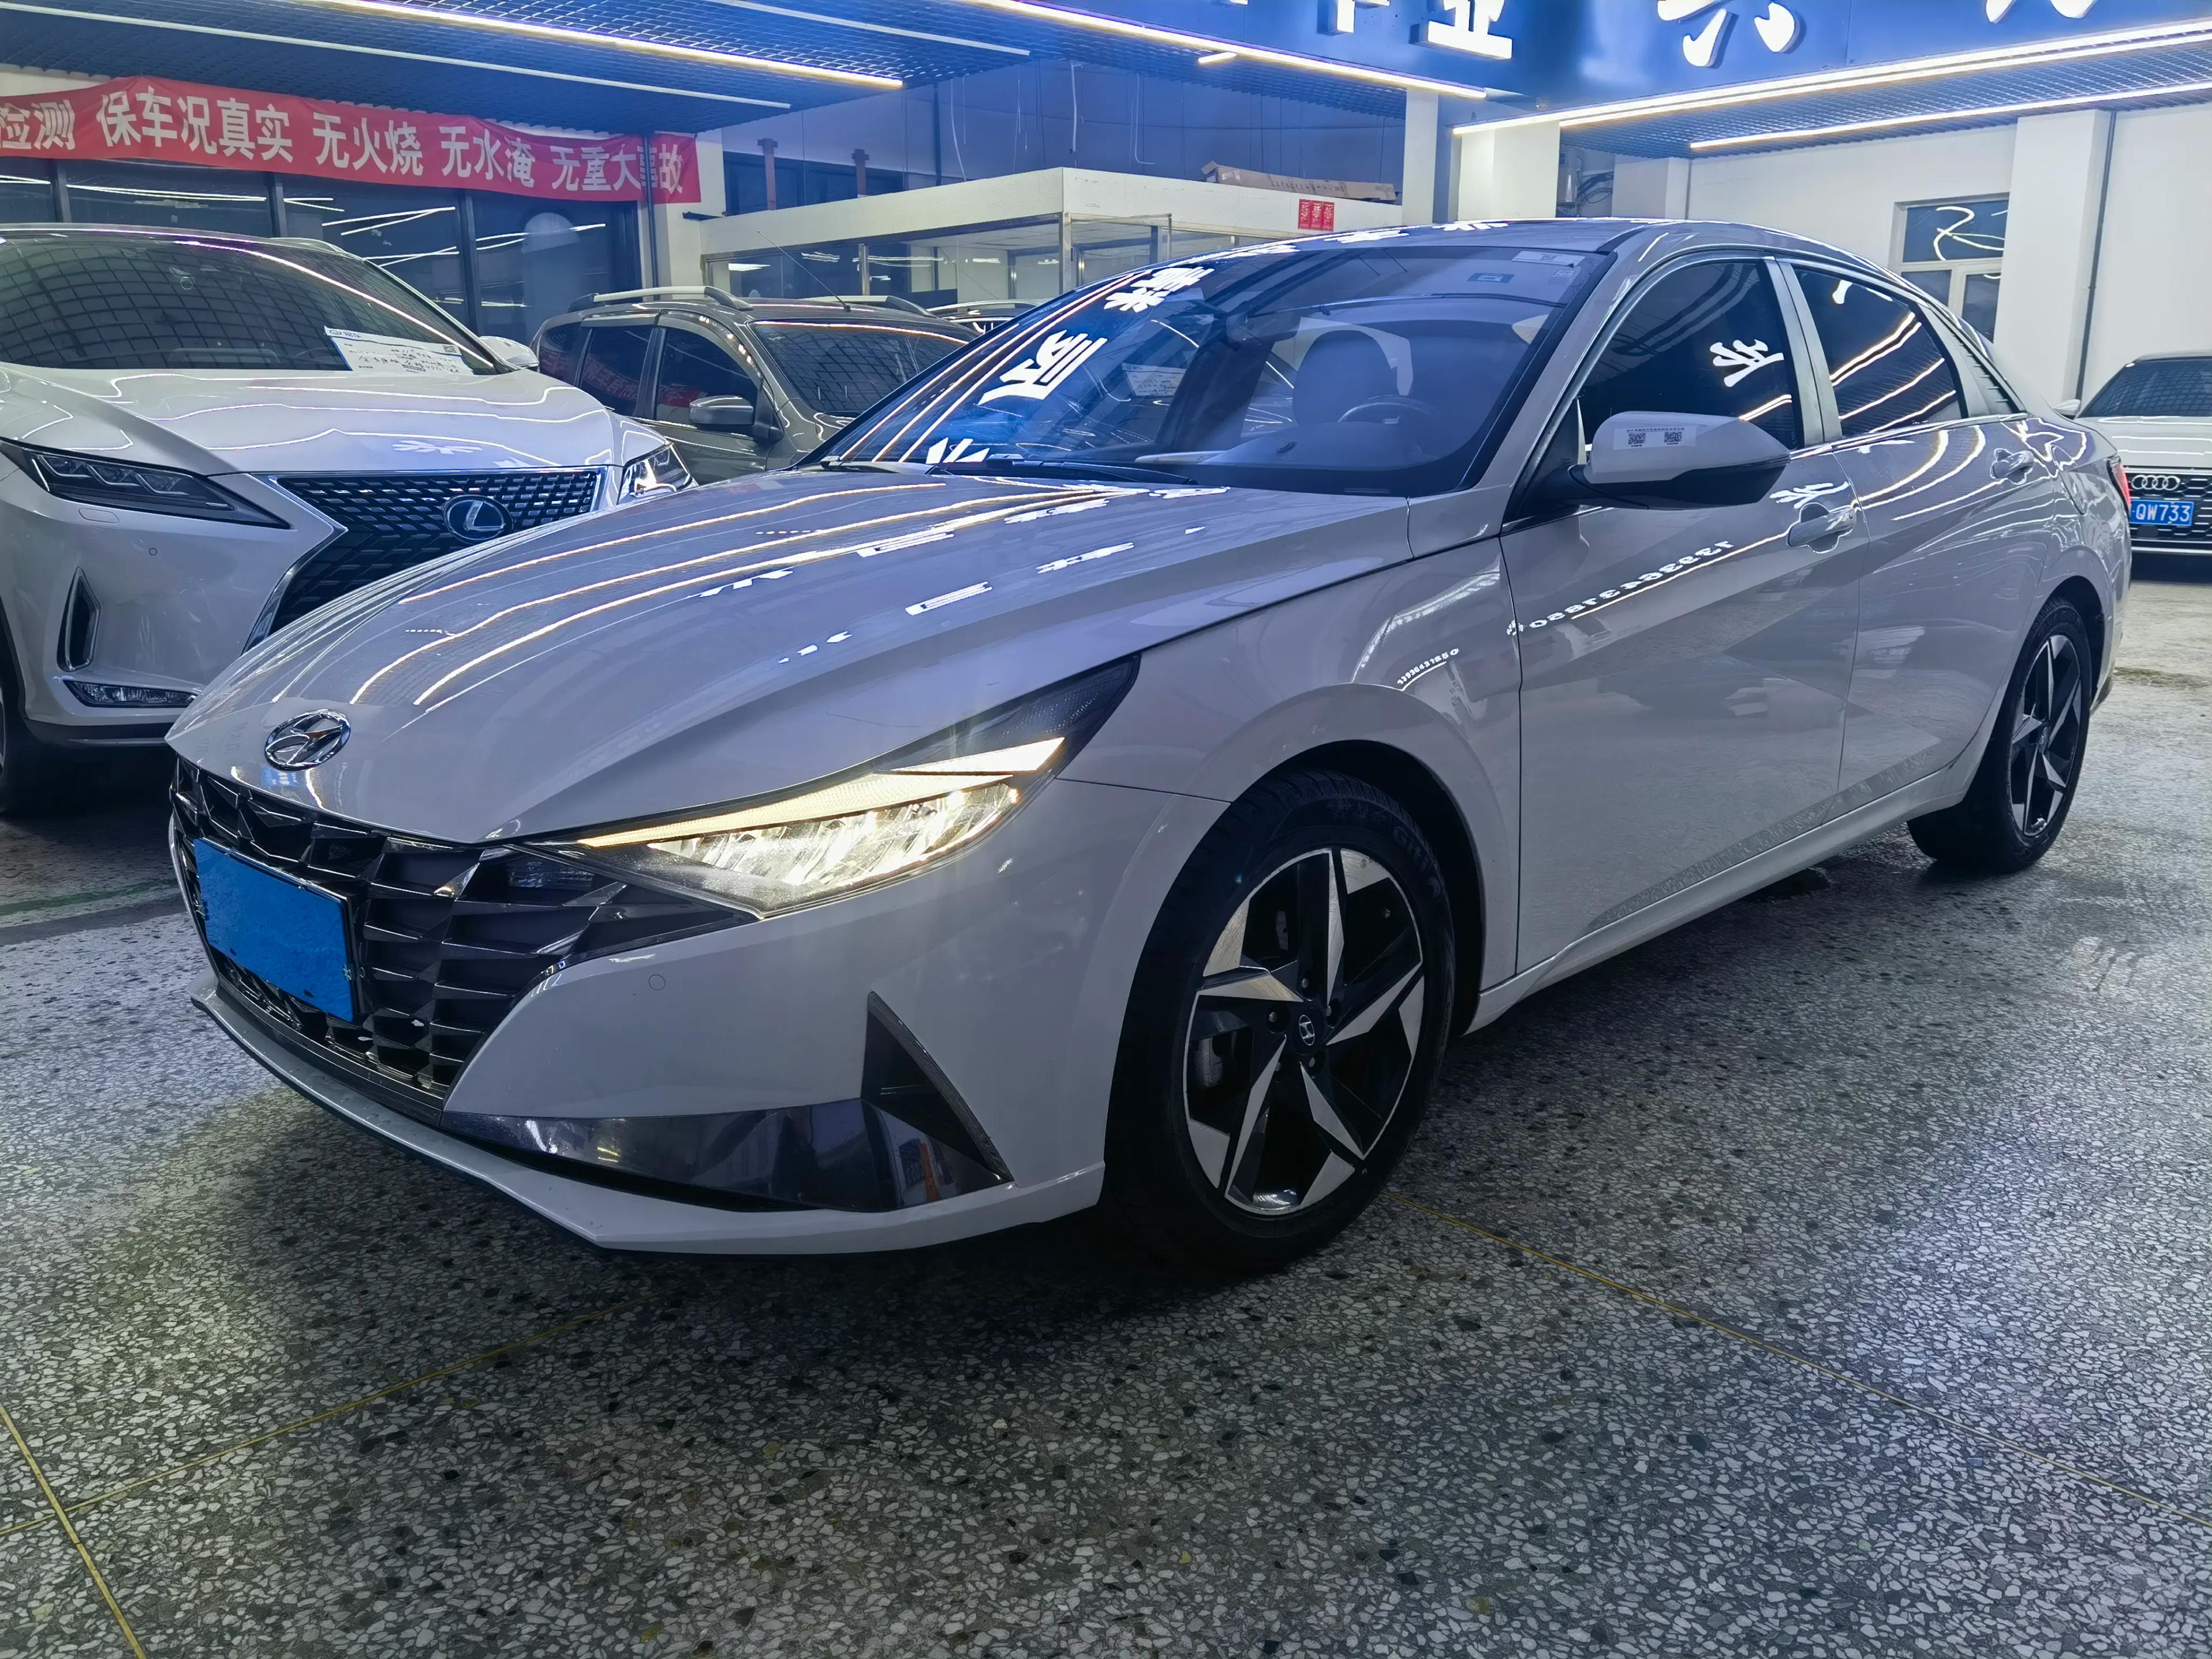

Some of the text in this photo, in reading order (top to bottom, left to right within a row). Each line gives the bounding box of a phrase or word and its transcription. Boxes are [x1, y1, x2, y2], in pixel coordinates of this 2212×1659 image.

[96, 85, 293, 162] 保车况真实
[312, 111, 423, 176] 无火烧
[439, 126, 535, 188] 无水淹
